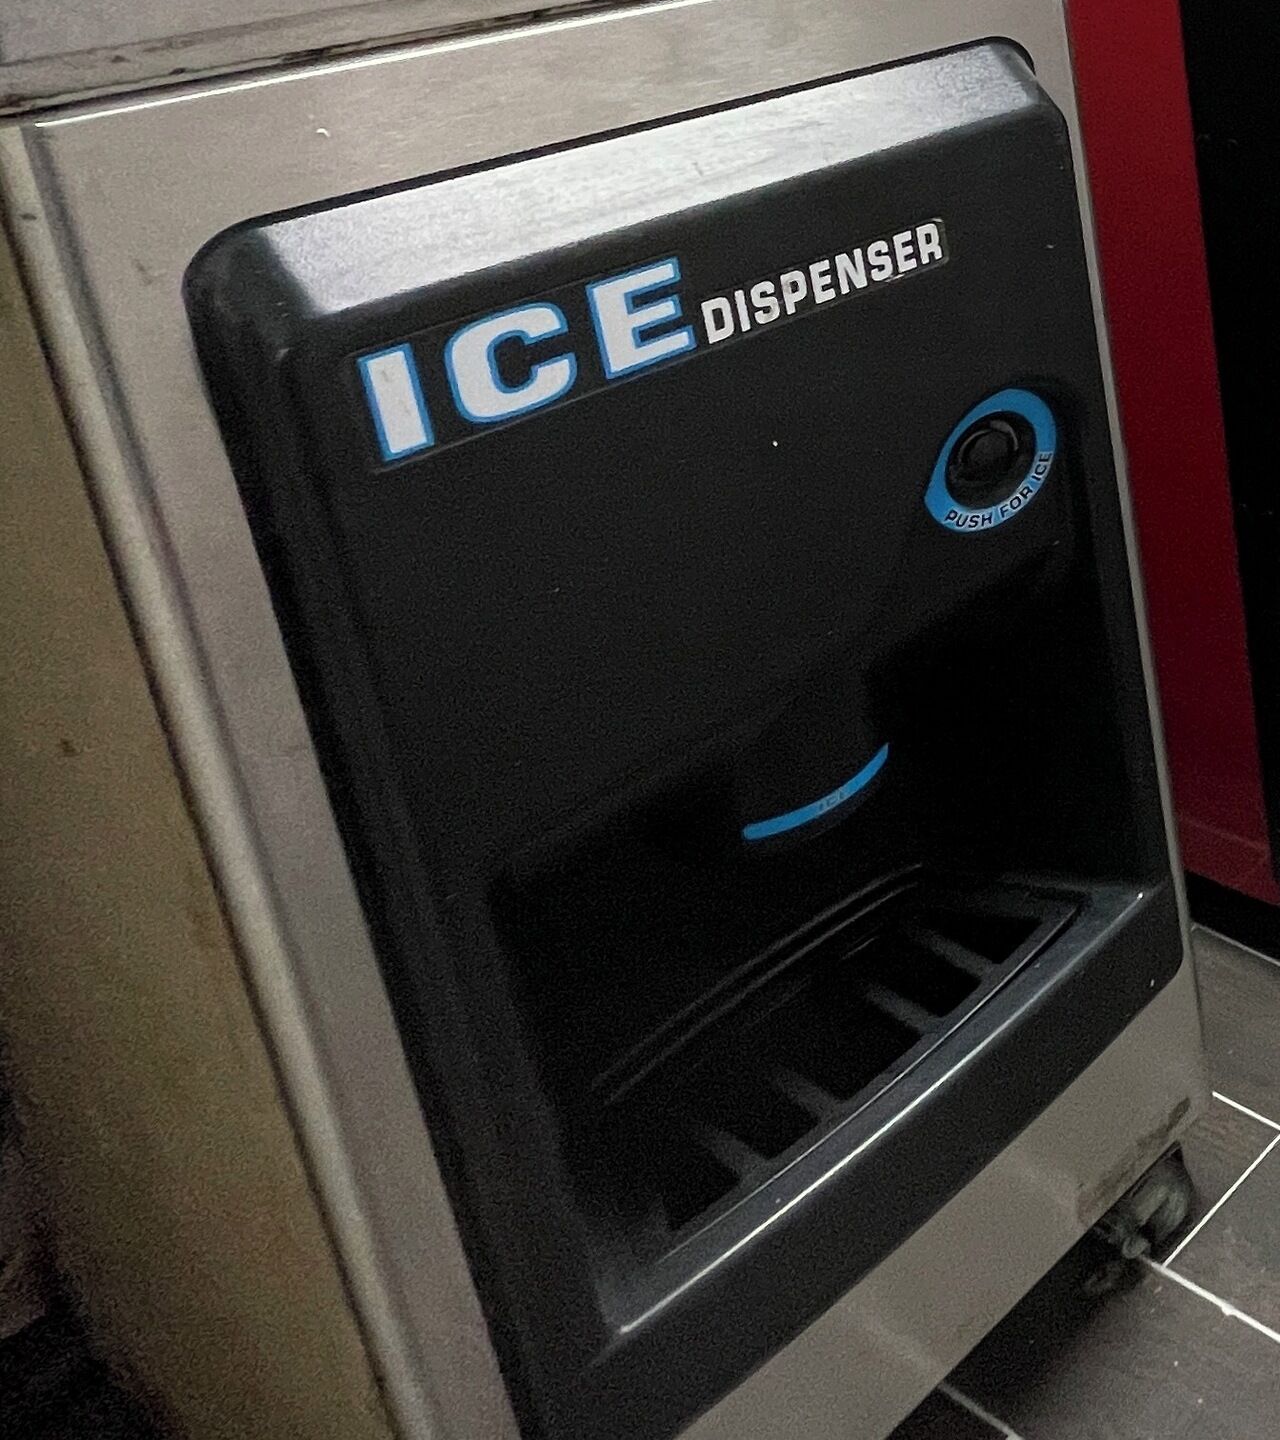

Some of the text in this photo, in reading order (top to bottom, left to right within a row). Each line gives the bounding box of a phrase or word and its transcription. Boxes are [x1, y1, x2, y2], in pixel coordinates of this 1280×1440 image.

[358, 222, 944, 461] ICE DISPENSER
[944, 452, 1053, 528] PUSH FOR ICE
